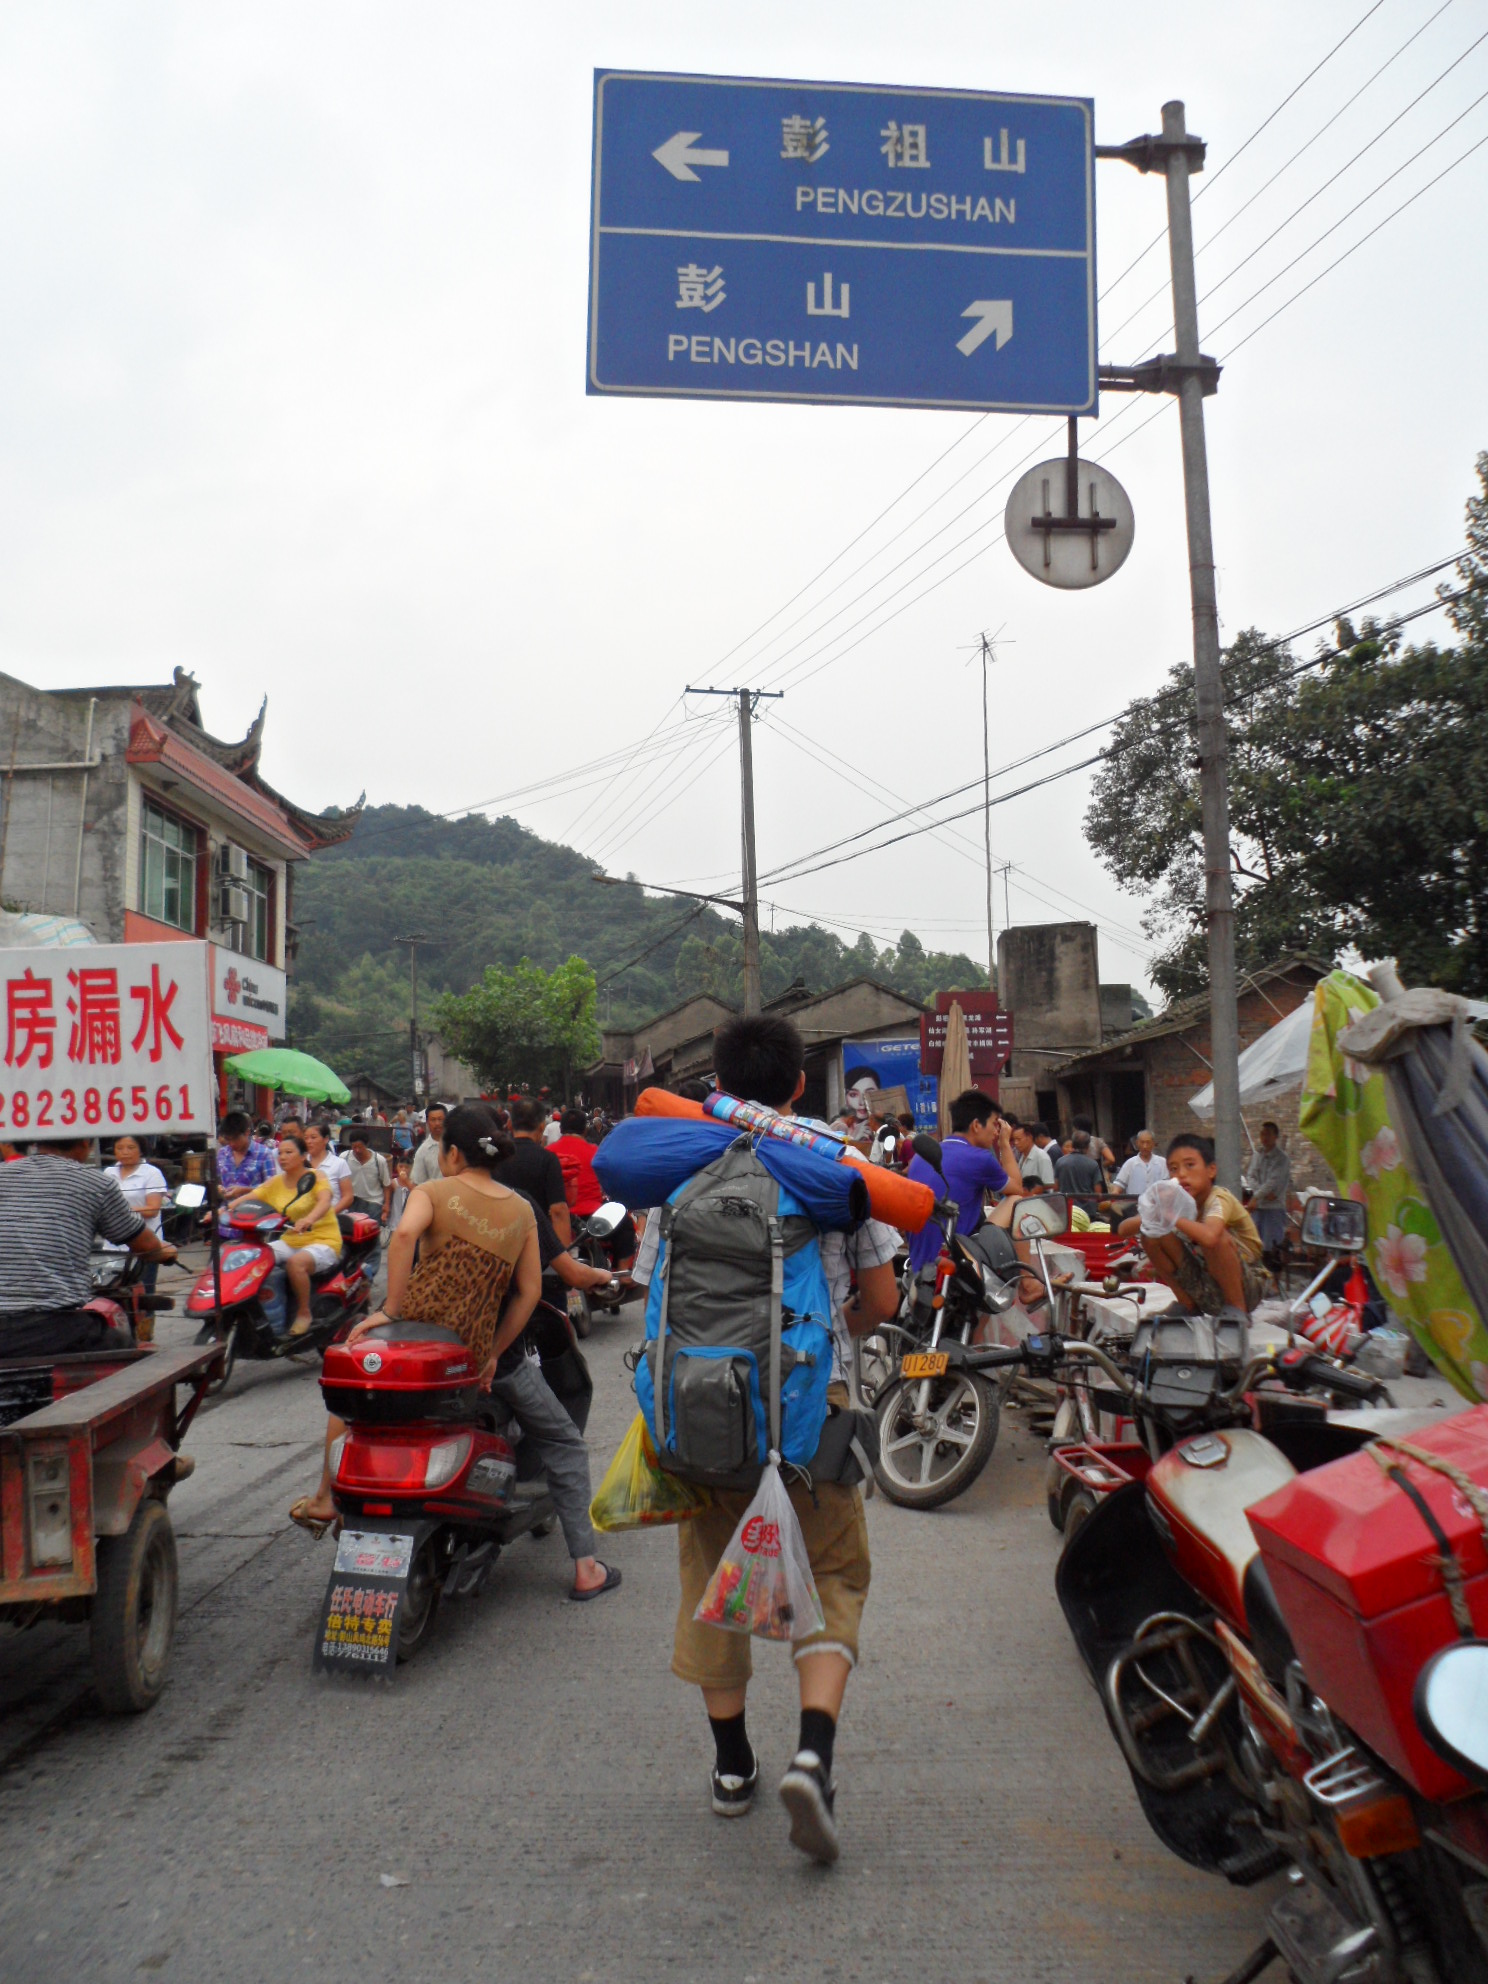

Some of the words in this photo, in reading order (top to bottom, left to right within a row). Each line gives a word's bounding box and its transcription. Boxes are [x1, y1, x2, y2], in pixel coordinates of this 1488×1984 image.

[780, 115, 1026, 174] 彭祖山
[795, 187, 1016, 224] PENGZUSHAN
[675, 263, 850, 318] 彭山
[667, 334, 859, 370] PENGSHAN
